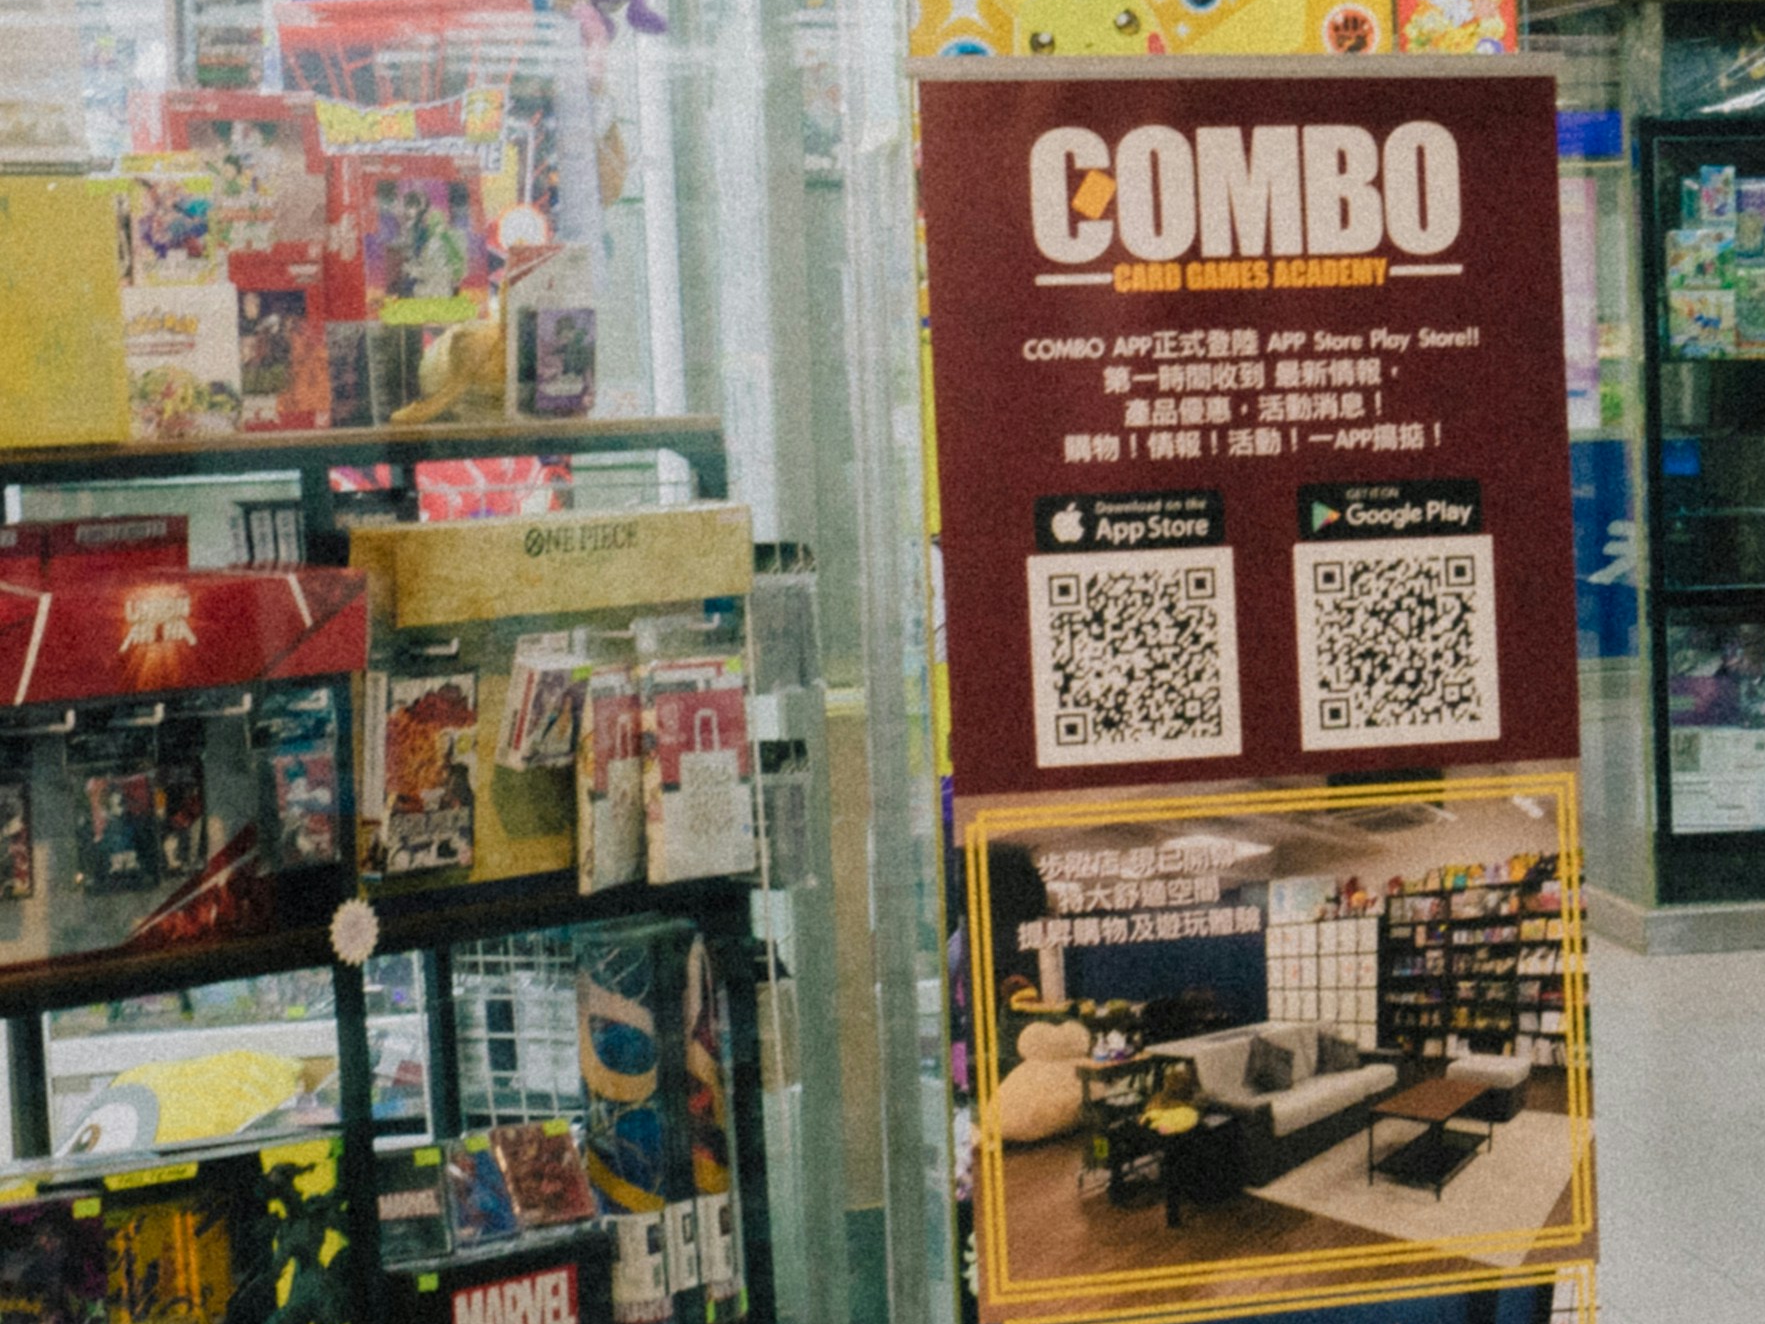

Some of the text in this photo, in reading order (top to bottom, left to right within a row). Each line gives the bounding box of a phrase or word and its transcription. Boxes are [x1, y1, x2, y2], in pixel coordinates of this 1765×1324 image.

[1028, 121, 1461, 265] COMBO
[1113, 257, 1388, 292] CARD GAMES ACADEMY
[1022, 326, 1480, 362] COMBO APP正式登陸 APP Store Play Store!!
[1102, 360, 1266, 395] 第一時間收到
[1095, 500, 1162, 514] Download
[1345, 499, 1473, 530] Google Play
[1095, 514, 1210, 545] App Store
